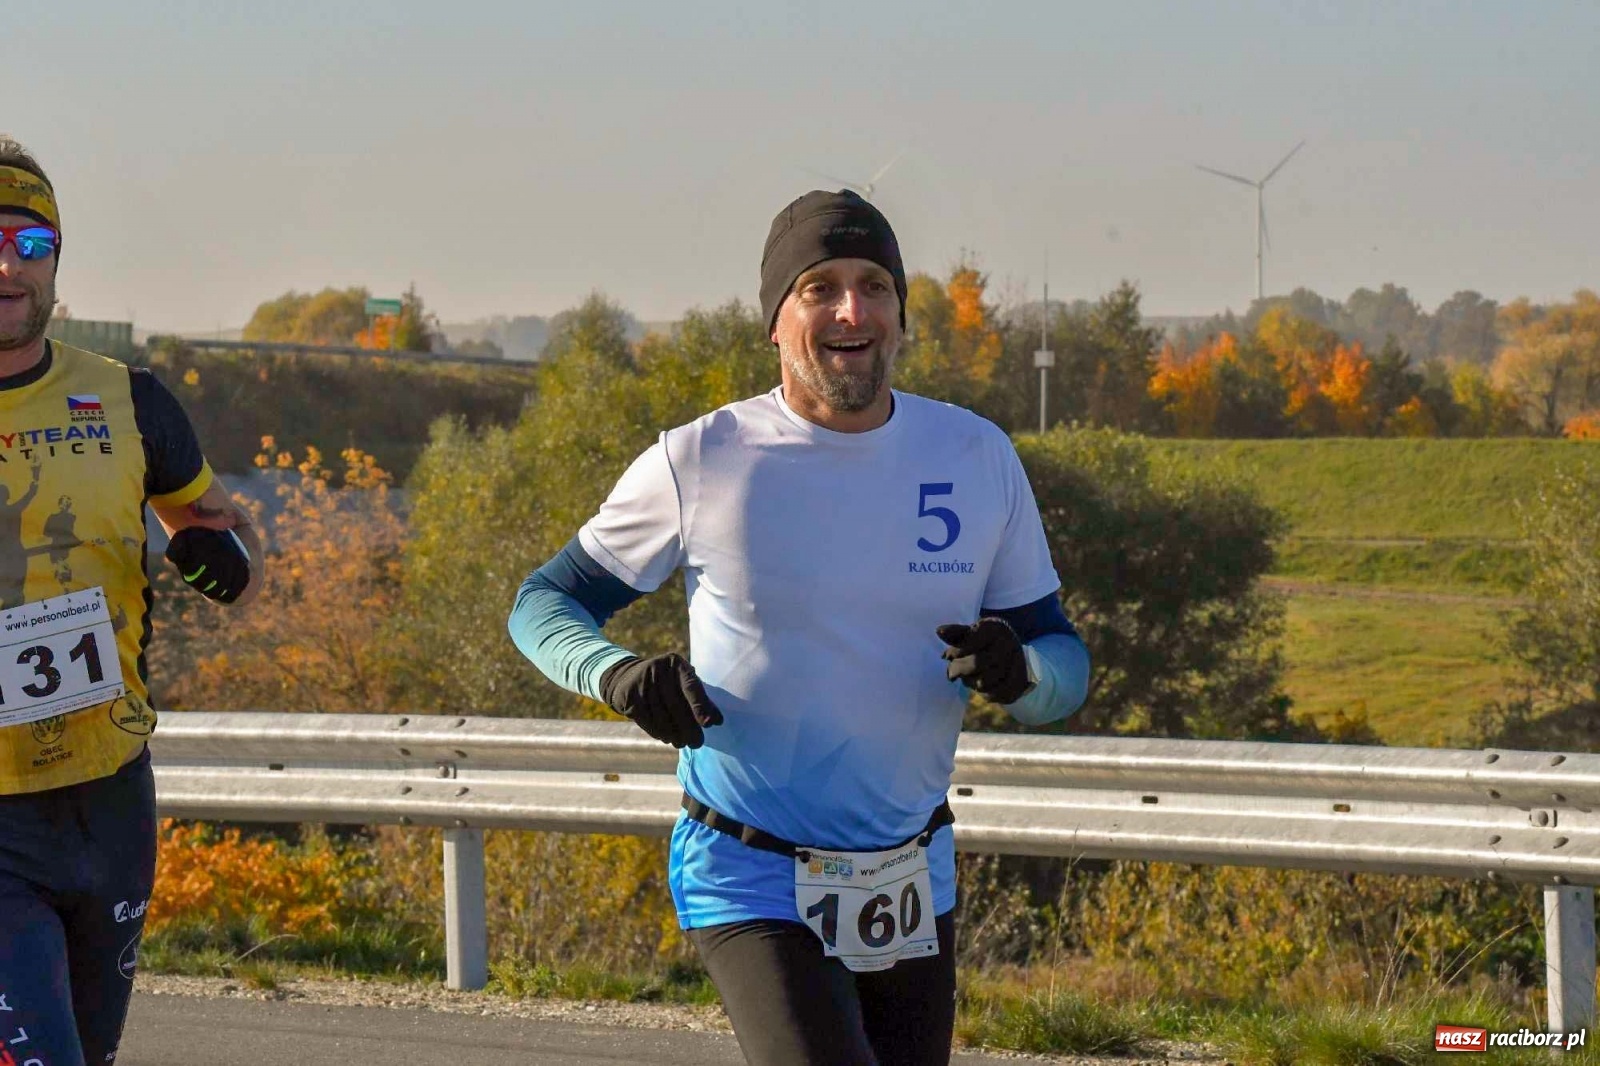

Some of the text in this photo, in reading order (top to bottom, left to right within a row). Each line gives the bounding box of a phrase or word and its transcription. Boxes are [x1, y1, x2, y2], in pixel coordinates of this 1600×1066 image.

[25, 424, 110, 445] TEAM
[917, 482, 961, 553] 5
[908, 559, 975, 574] RACIBÓRZ
[5, 600, 101, 632] www.personalbest.pl
[0, 632, 104, 705] 31
[40, 744, 64, 756] OBEC
[807, 882, 921, 948] 160
